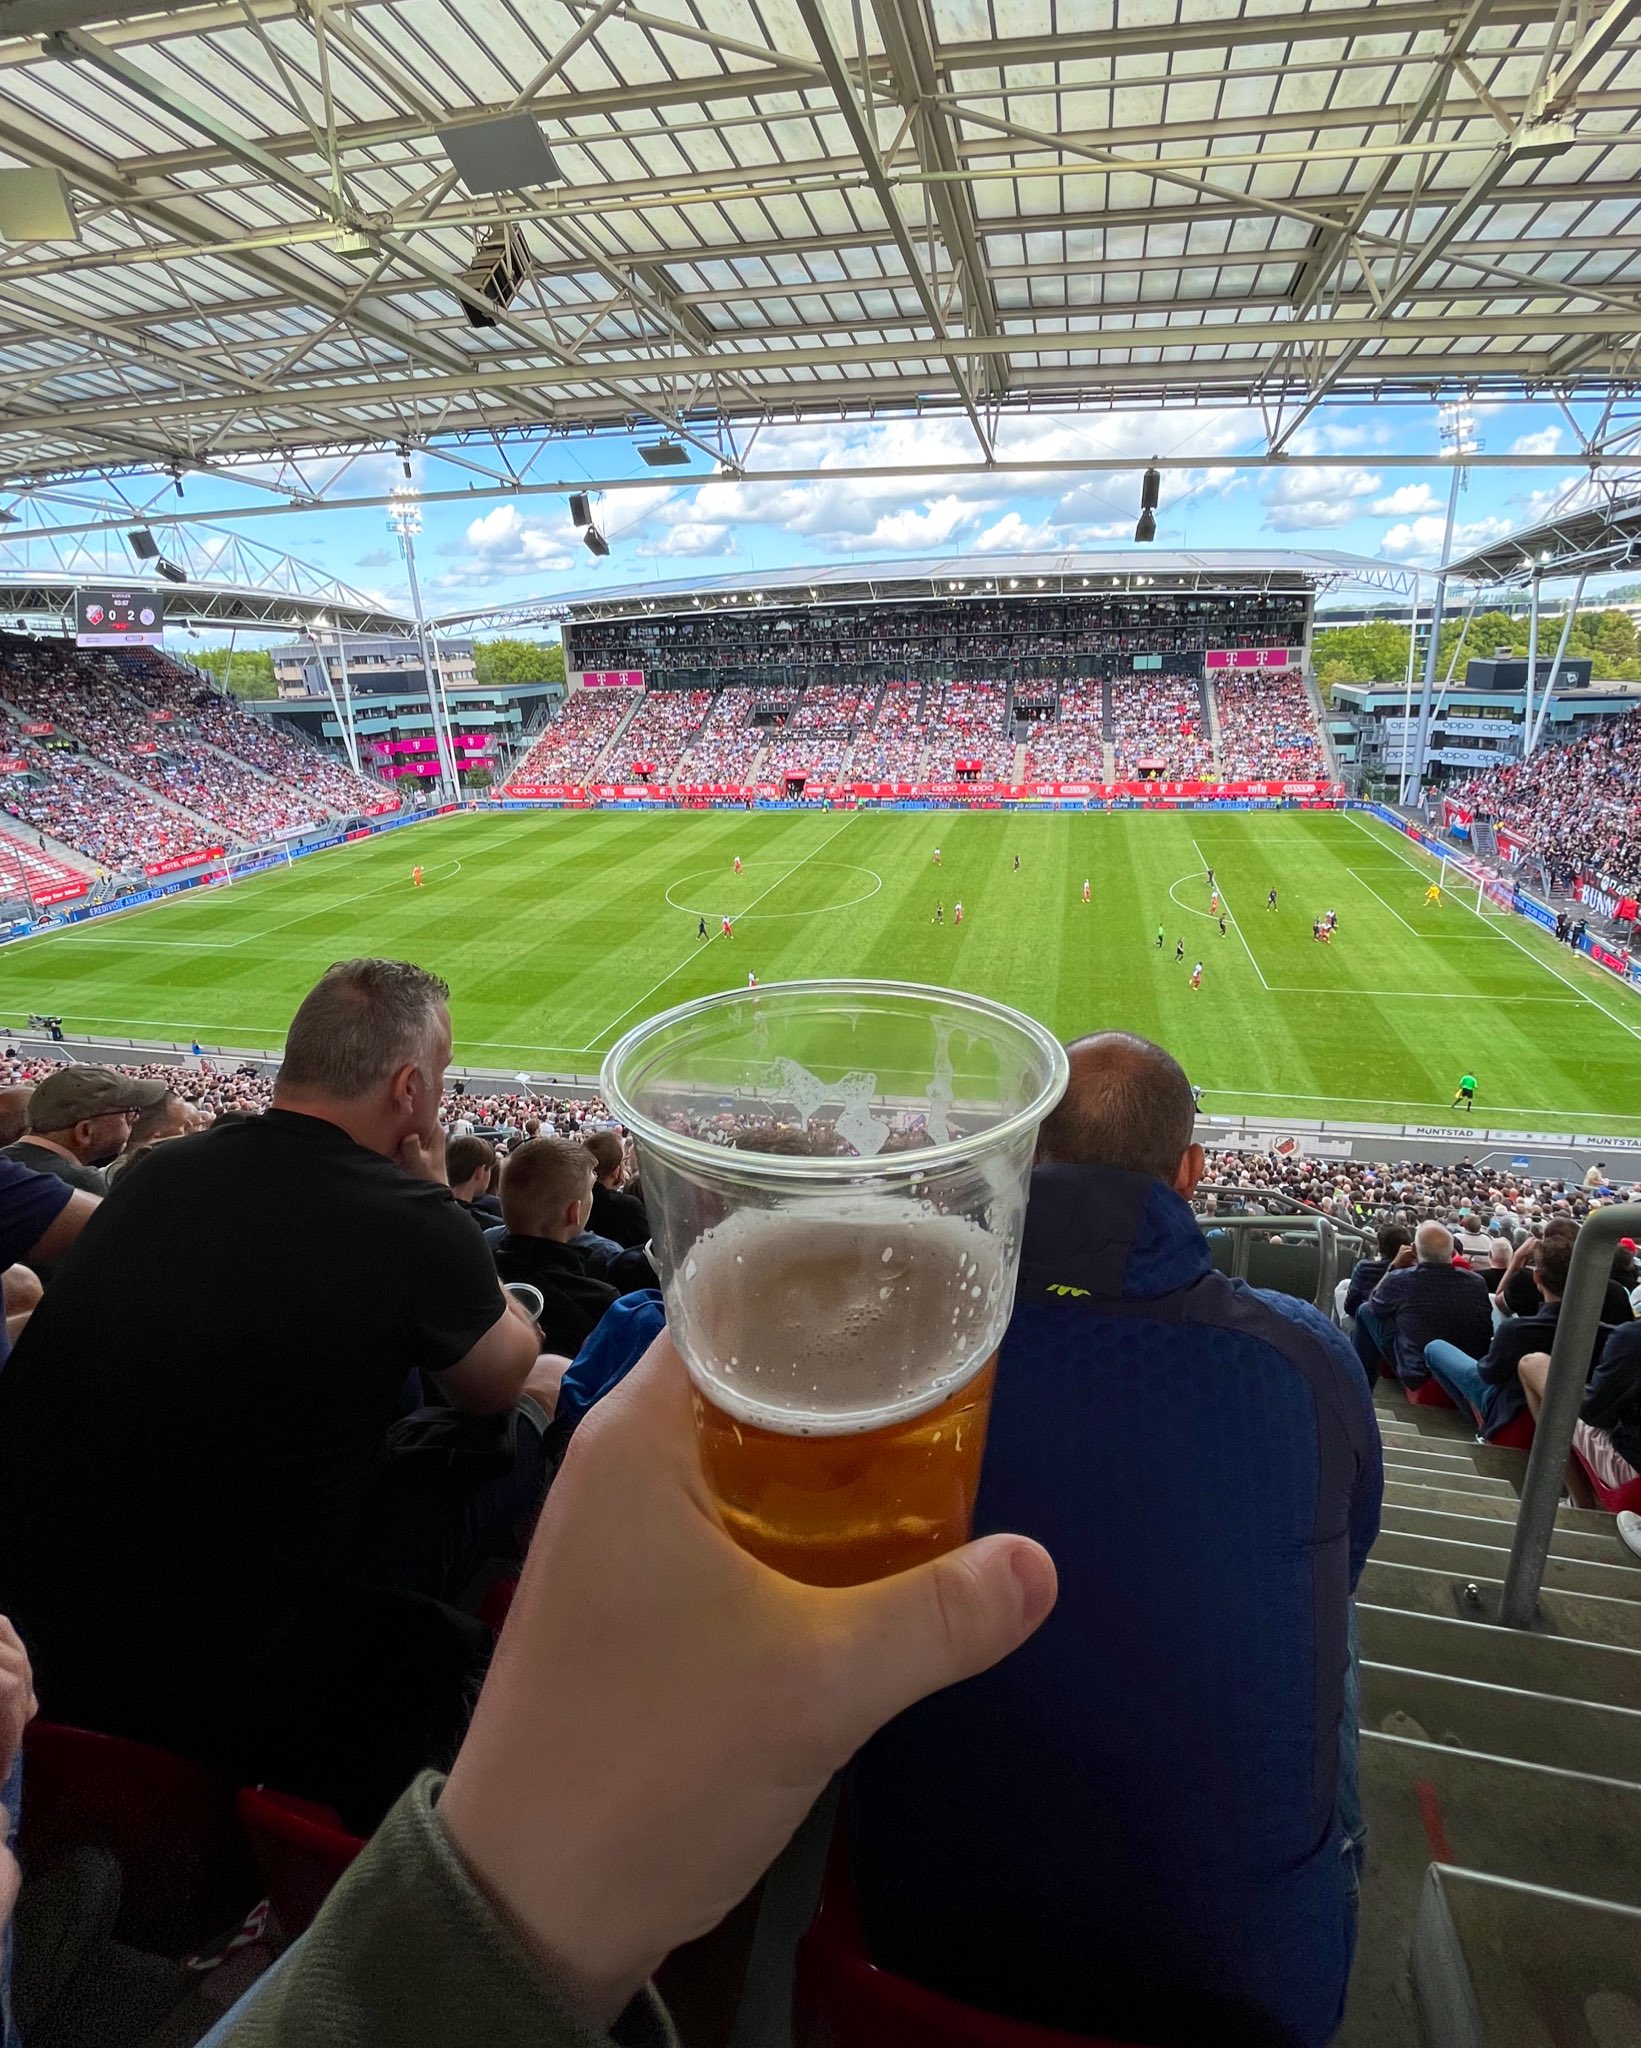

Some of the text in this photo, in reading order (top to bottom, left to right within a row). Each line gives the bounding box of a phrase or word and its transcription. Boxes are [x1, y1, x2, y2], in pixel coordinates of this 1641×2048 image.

[108, 610, 116, 620] 0
[127, 610, 135, 620] 2
[1442, 722, 1474, 730] oppo
[1482, 724, 1516, 732] oppo
[1438, 751, 1470, 760] oppo
[1477, 753, 1511, 763] oppo
[512, 787, 536, 795] oppo
[539, 787, 564, 795] oppo
[160, 861, 182, 871] HOTEL
[181, 853, 207, 866] UTRECHT
[89, 884, 180, 916] EREDIVISIE AWARDS 2021 2022
[1602, 953, 1625, 973] ESPN
[1416, 1128, 1474, 1137] MUNTSTAD
[1586, 1137, 1641, 1147] MUNTSTA
